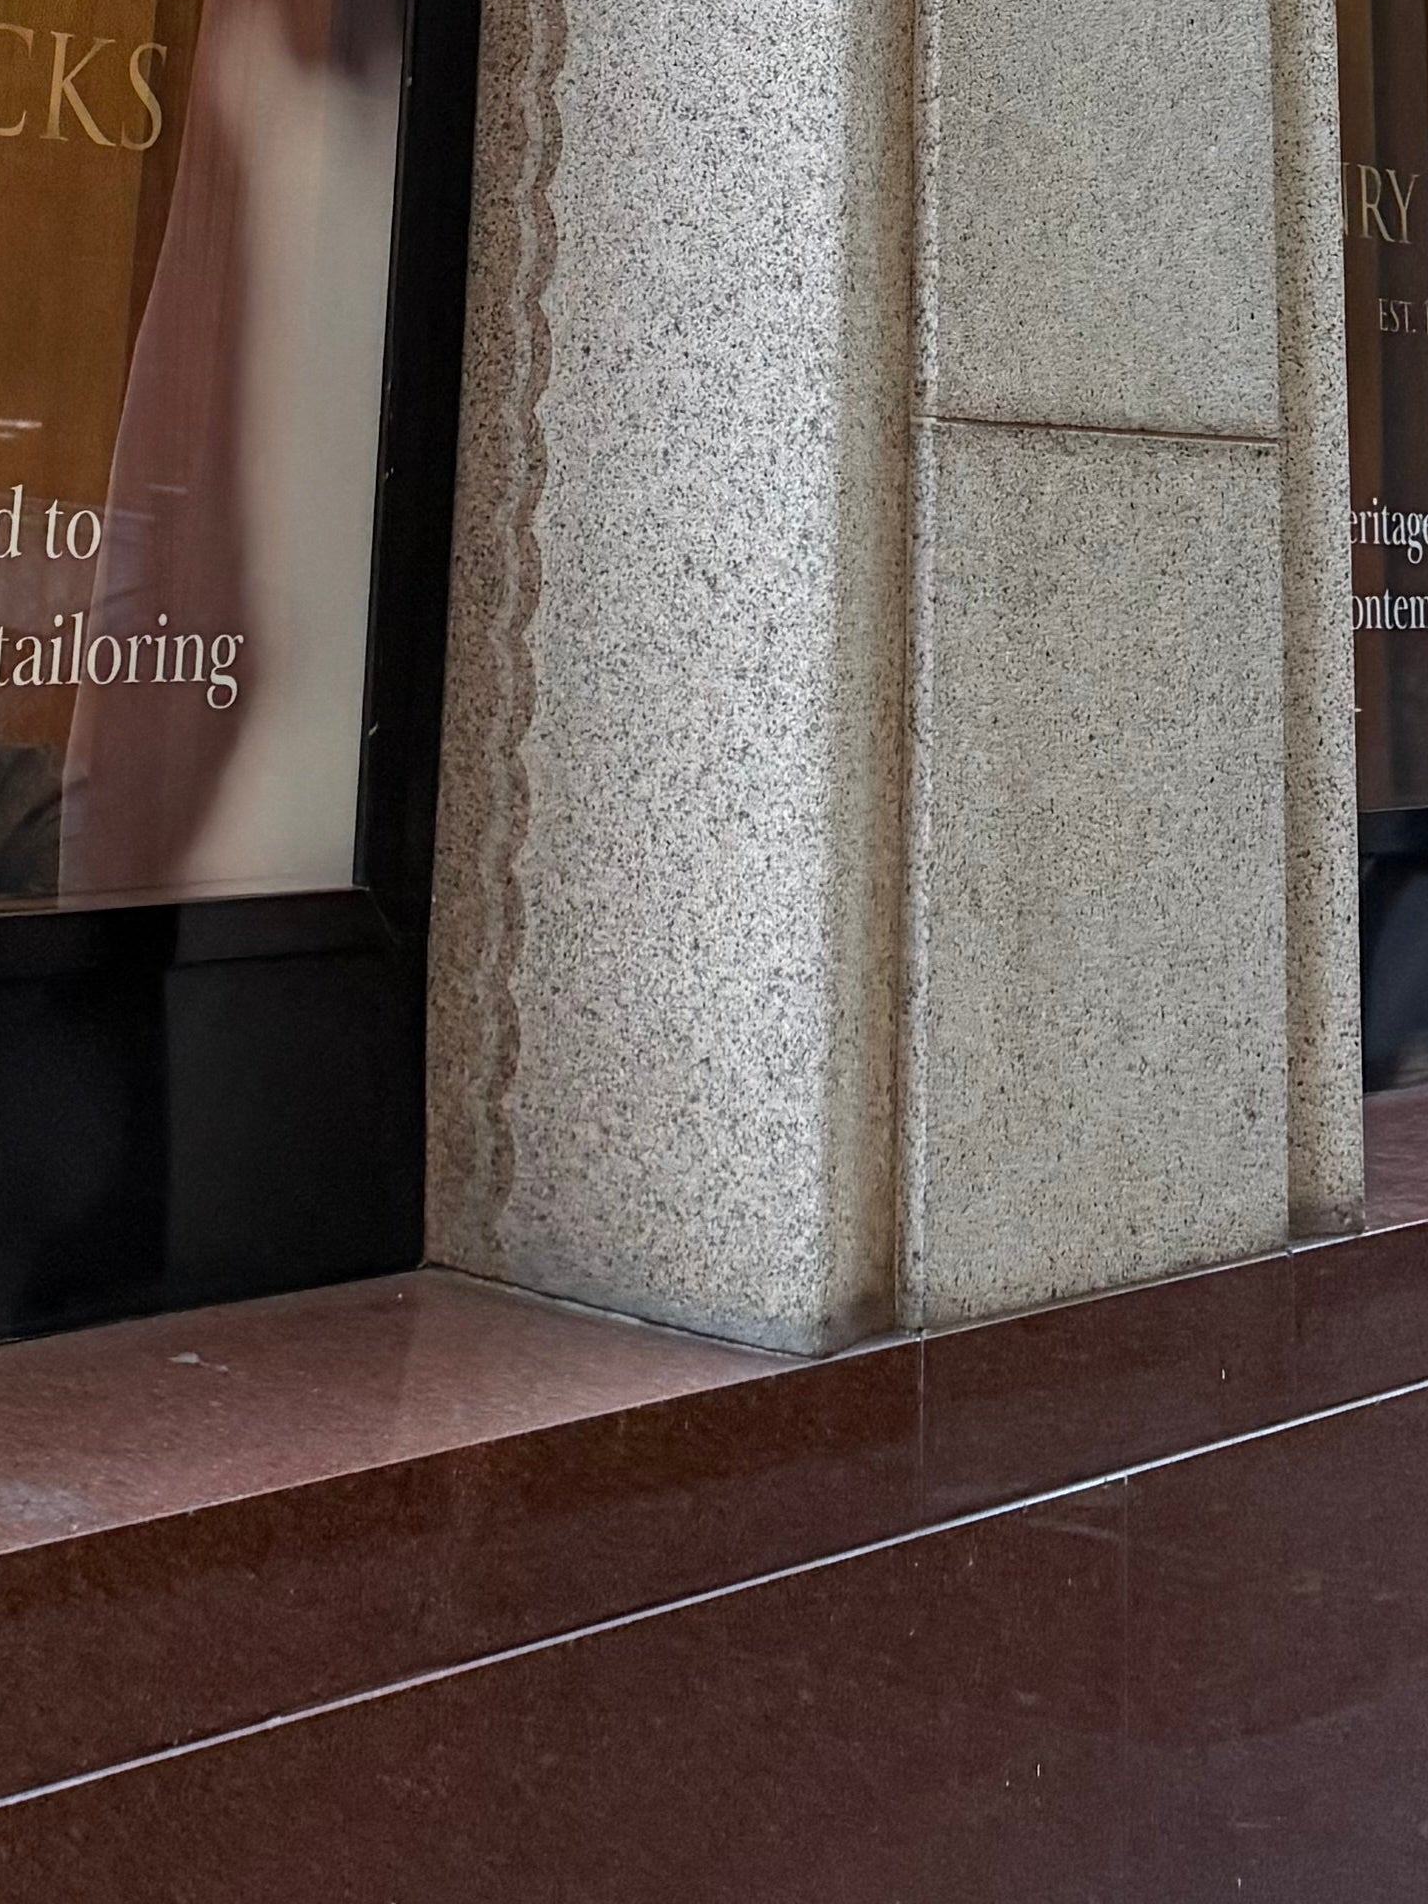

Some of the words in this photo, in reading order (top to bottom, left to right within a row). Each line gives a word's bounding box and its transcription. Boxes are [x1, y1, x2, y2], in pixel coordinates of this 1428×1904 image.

[1341, 161, 1420, 245] RY
[1379, 297, 1417, 334] EST.
[45, 497, 102, 560] to
